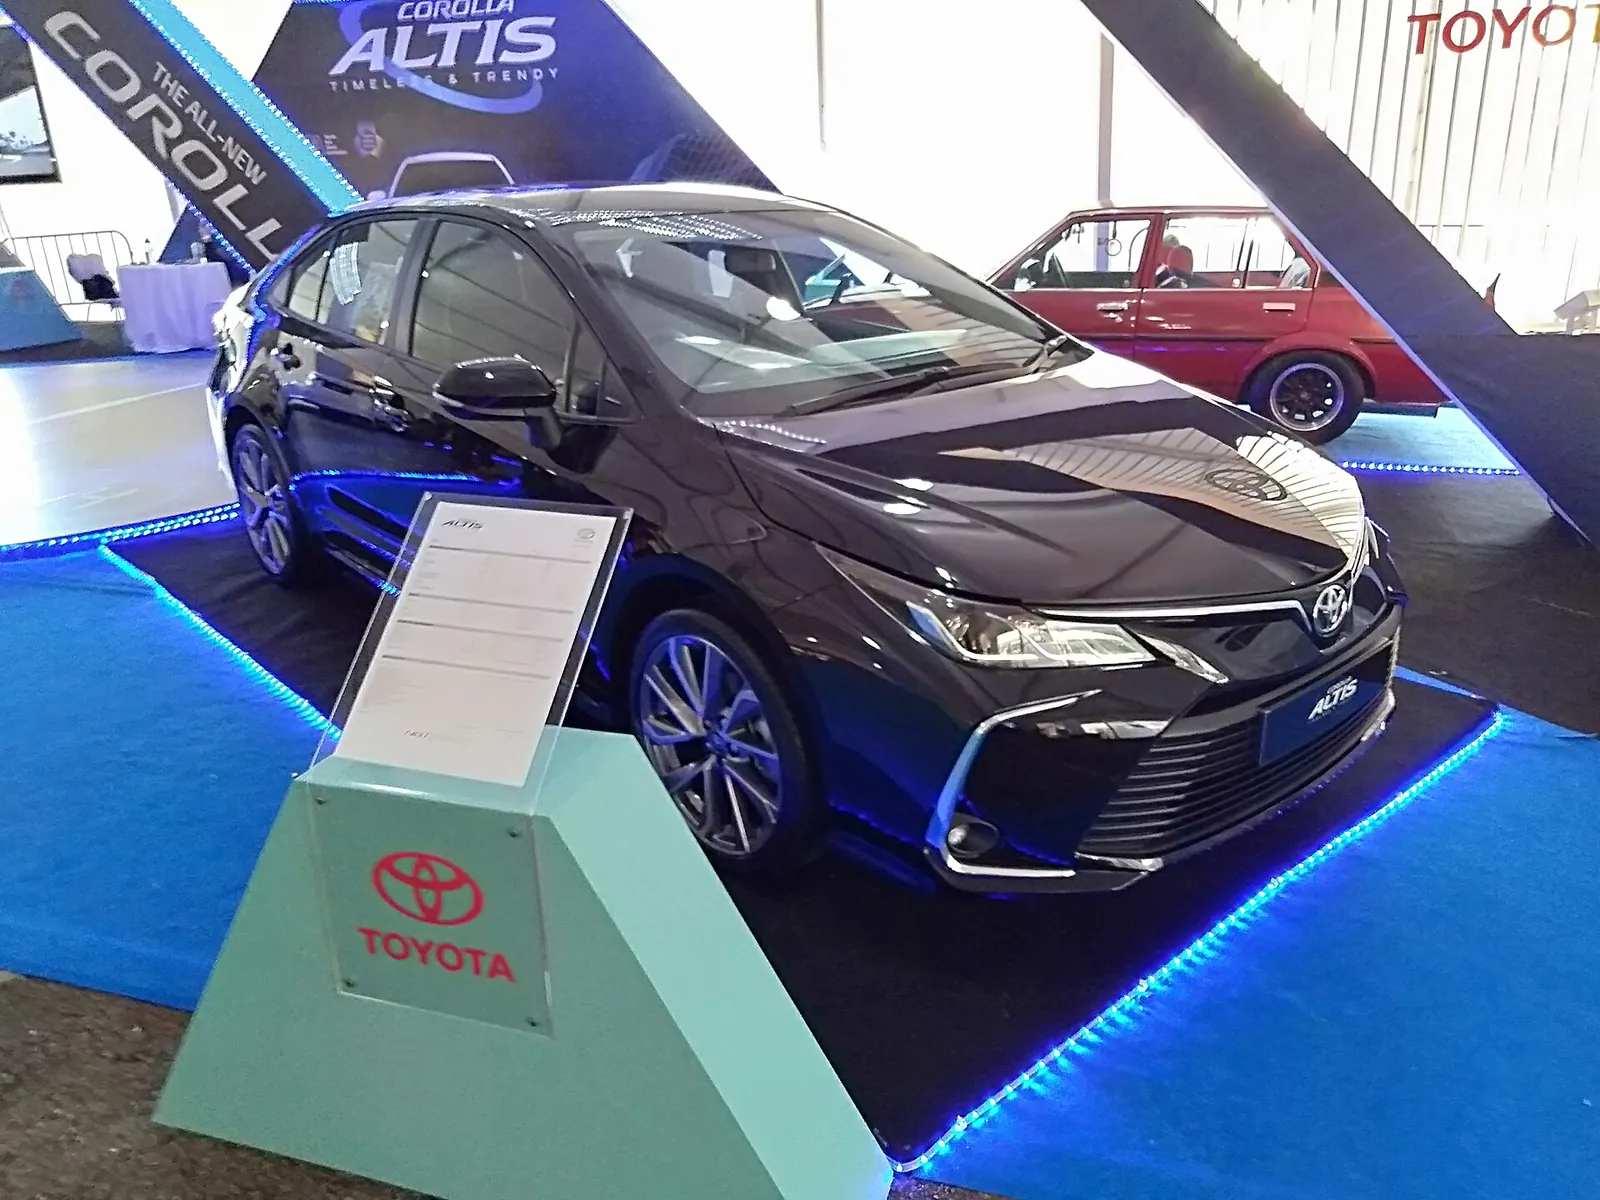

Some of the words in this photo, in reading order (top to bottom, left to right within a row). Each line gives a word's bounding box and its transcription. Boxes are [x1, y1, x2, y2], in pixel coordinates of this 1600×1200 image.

[397, 0, 514, 20] COROLLA
[1407, 4, 1600, 55] TOYOT
[328, 16, 557, 75] ALTIS
[472, 67, 559, 83] TRENDY
[44, 11, 282, 263] COROLL
[150, 61, 190, 108] THE
[184, 101, 268, 186] ALL-NEW
[1308, 679, 1358, 720] ALTIS
[356, 926, 516, 983] TOYOTA
